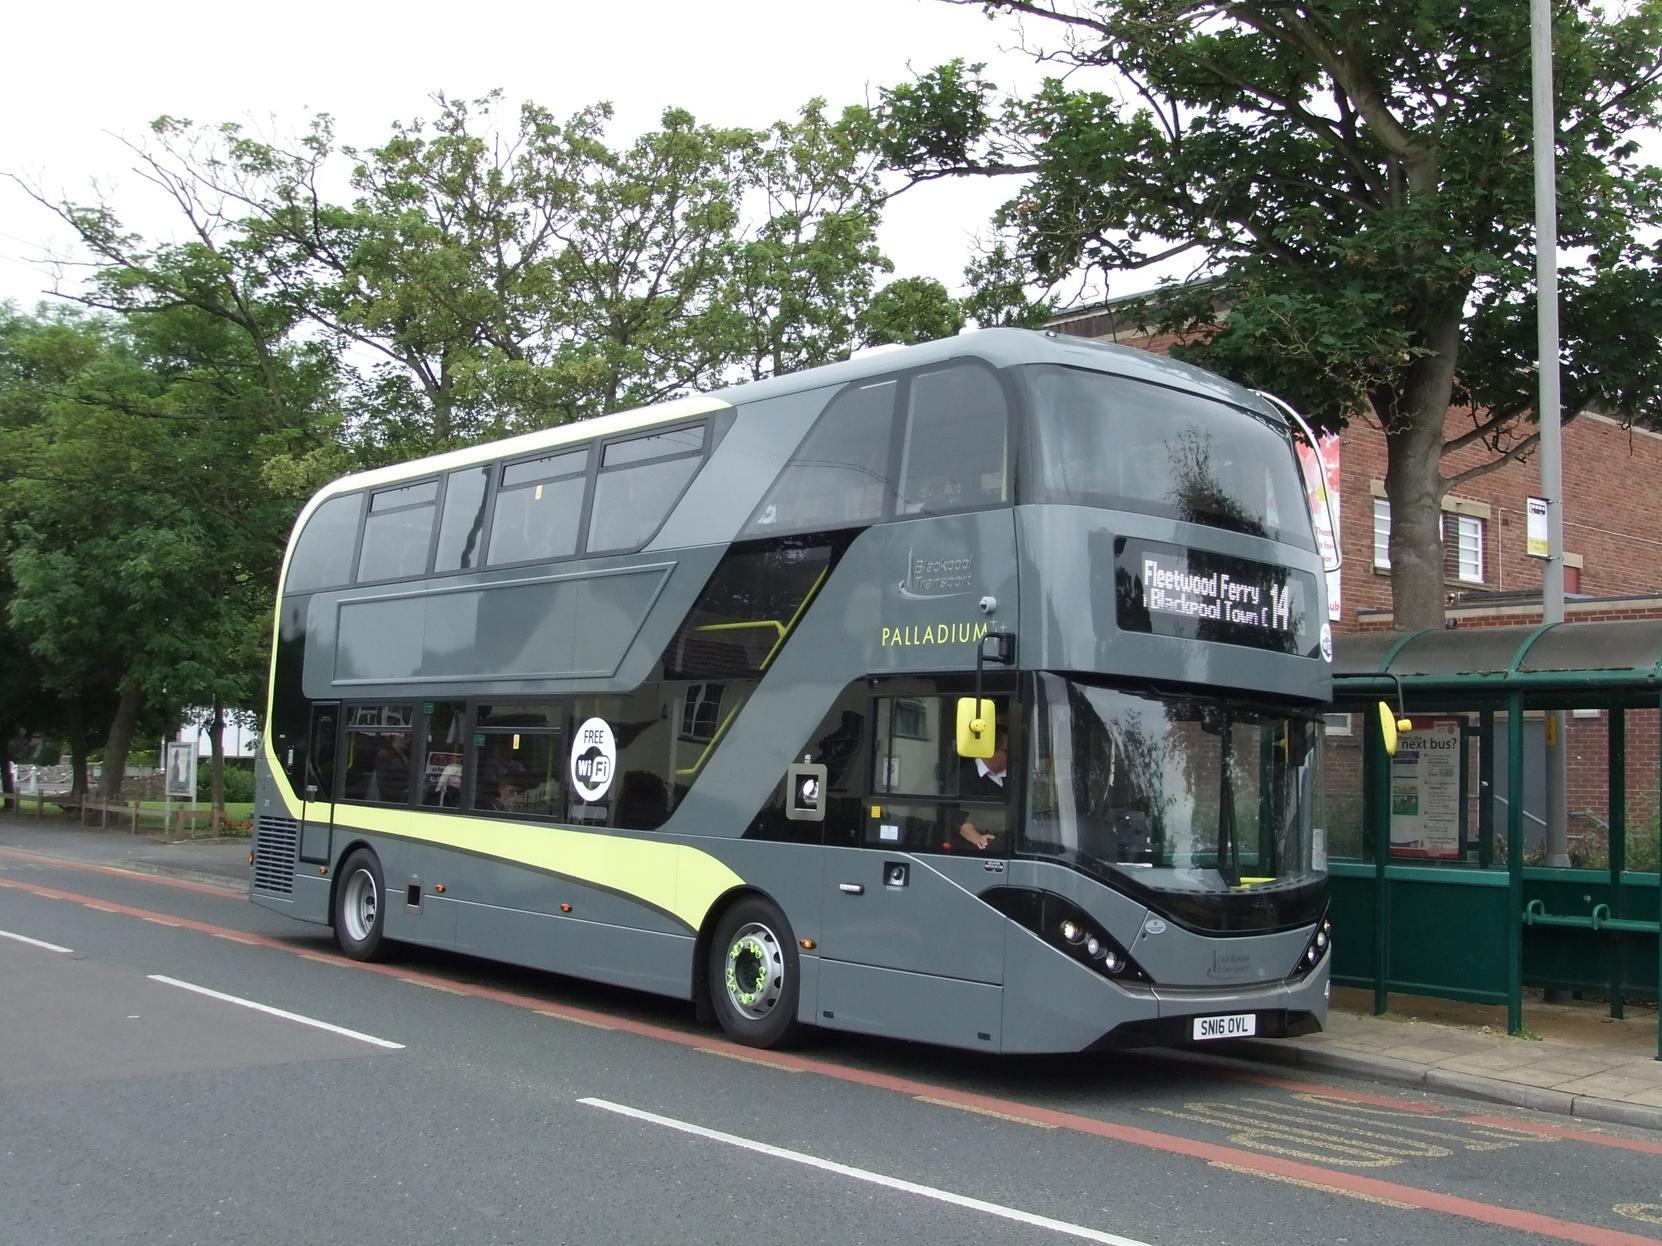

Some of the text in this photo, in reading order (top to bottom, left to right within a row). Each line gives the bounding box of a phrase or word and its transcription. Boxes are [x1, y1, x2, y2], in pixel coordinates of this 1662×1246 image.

[915, 554, 974, 574] Blackpool
[914, 575, 973, 591] Transport
[1144, 559, 1260, 604] Fleetwood Ferry
[1151, 588, 1221, 619] Blackpool
[1224, 600, 1259, 625] Town
[1270, 583, 1289, 630] 14
[882, 622, 988, 646] PALLADIUM
[583, 729, 604, 744] FREE
[1402, 738, 1427, 750] next
[1431, 737, 1457, 750] bus?
[1201, 1017, 1249, 1036] SN16 OVL
